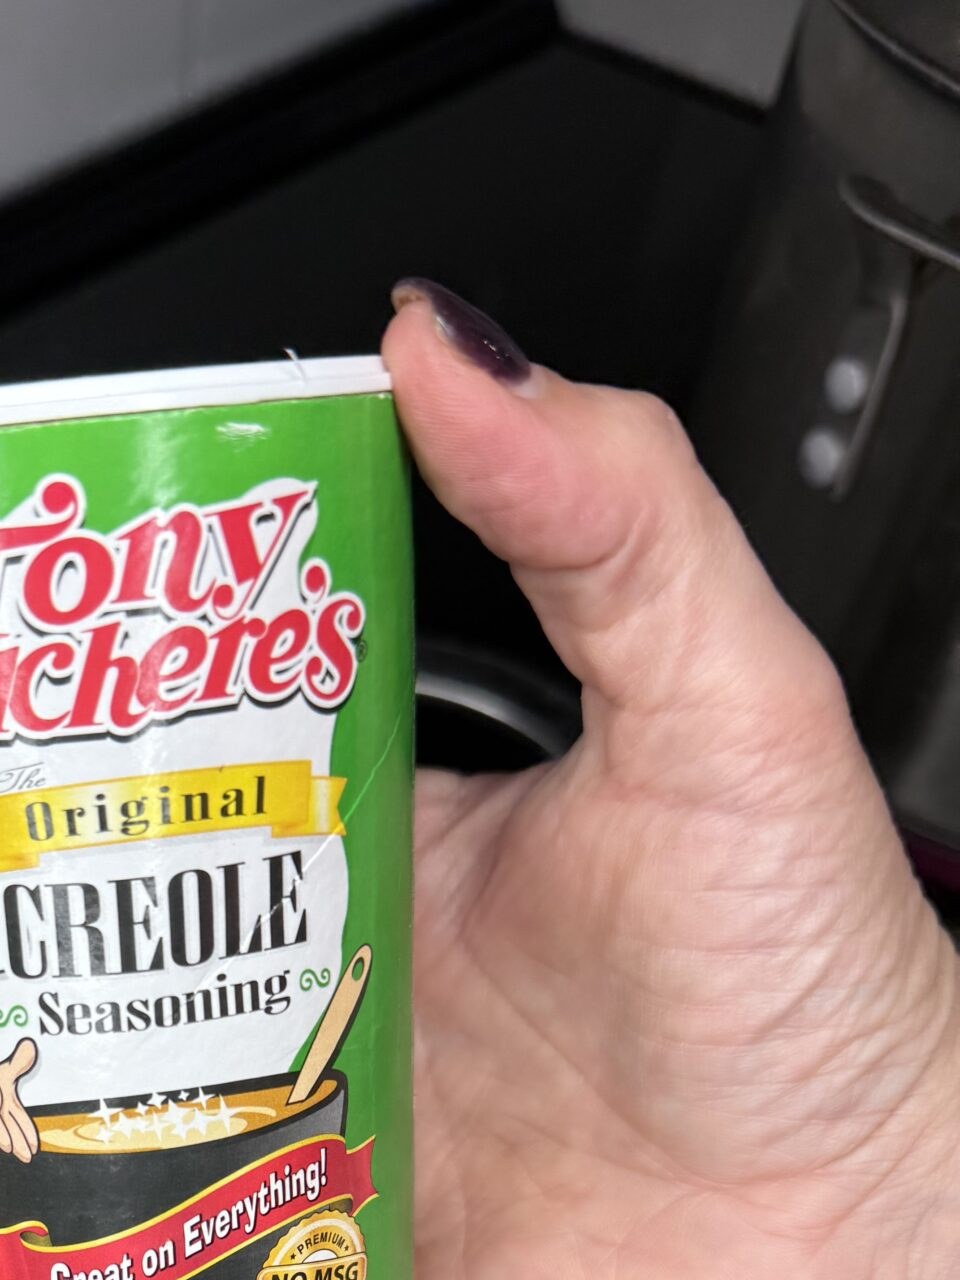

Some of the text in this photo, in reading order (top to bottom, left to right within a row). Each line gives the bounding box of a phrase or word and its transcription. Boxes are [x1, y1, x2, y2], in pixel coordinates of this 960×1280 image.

[24, 776, 268, 836] Original
[3, 850, 308, 980] CREOLE
[38, 969, 291, 1036] Seasoning
[141, 1239, 176, 1277] on
[182, 1147, 328, 1259] Everything!
[296, 1231, 345, 1255] PREMIUM
